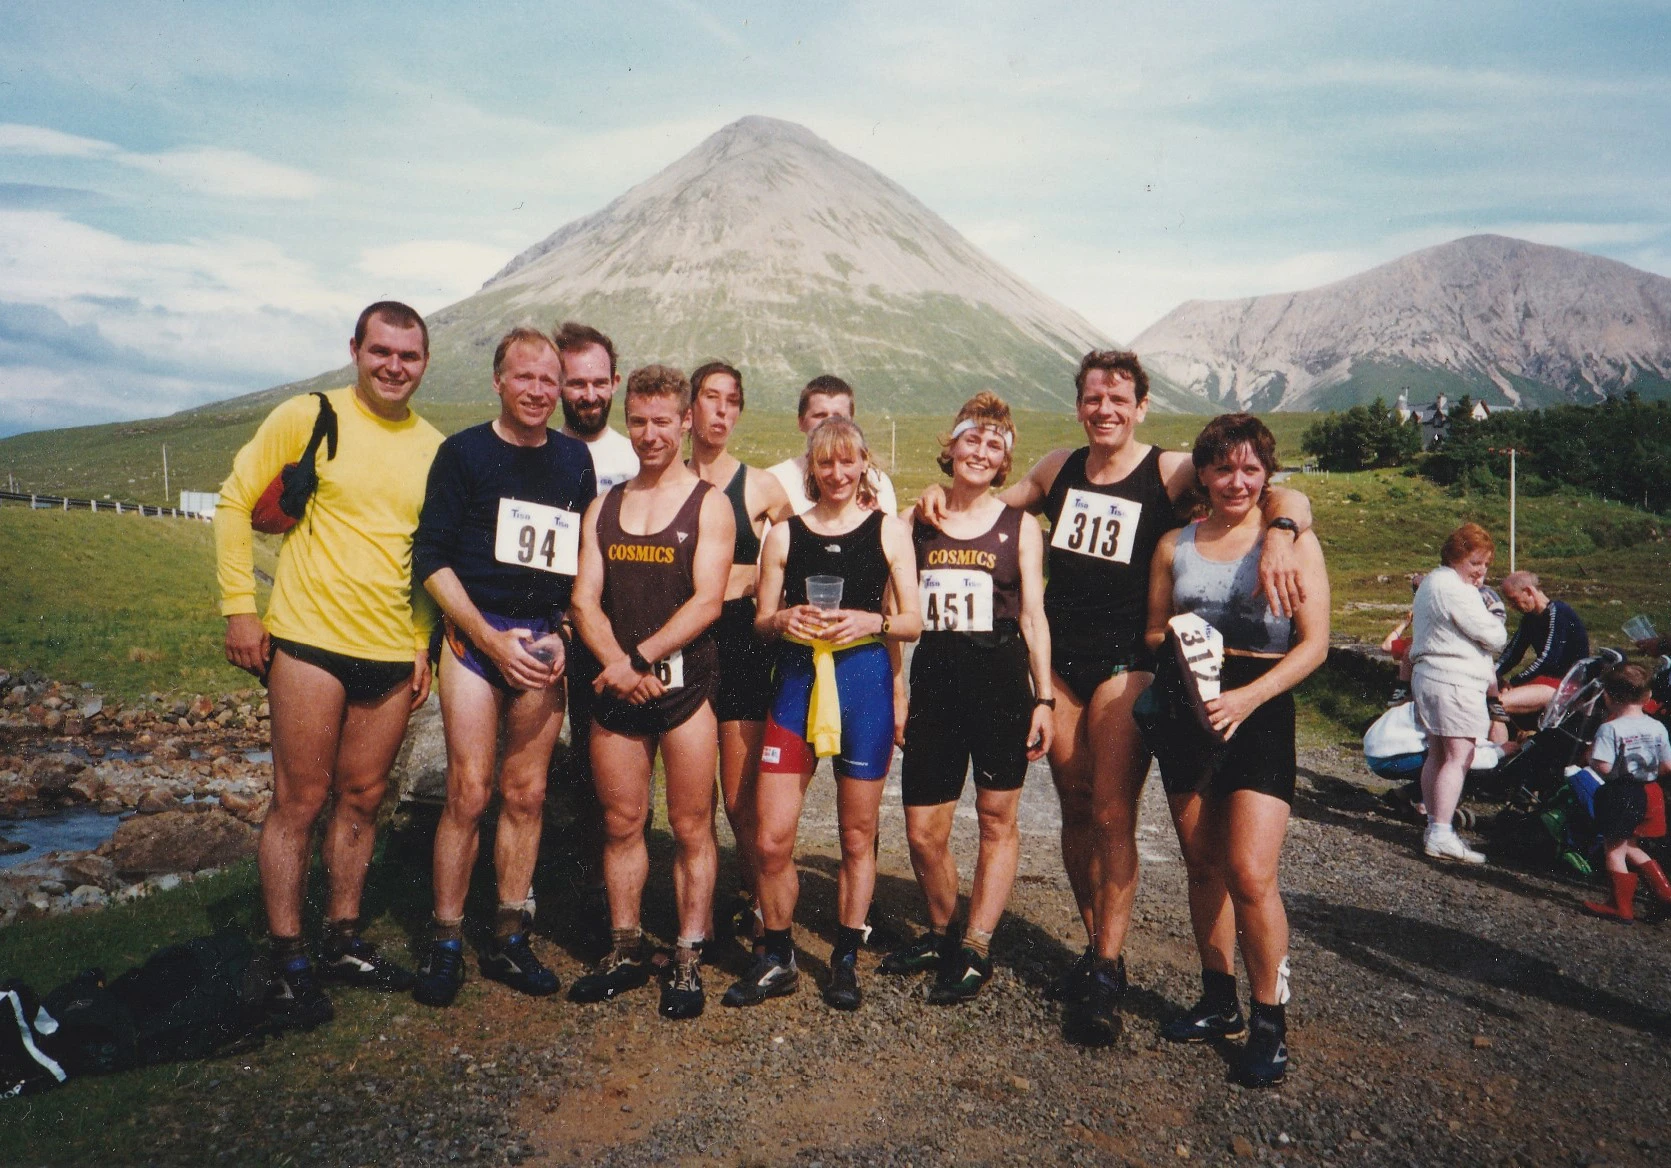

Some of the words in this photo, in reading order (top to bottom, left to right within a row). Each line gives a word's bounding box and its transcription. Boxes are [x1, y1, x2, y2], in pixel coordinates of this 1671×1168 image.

[518, 525, 556, 567] 94
[608, 543, 675, 564] COSMICS
[1068, 512, 1121, 557] 313
[928, 549, 997, 569] COSMICS
[927, 592, 974, 632] 451
